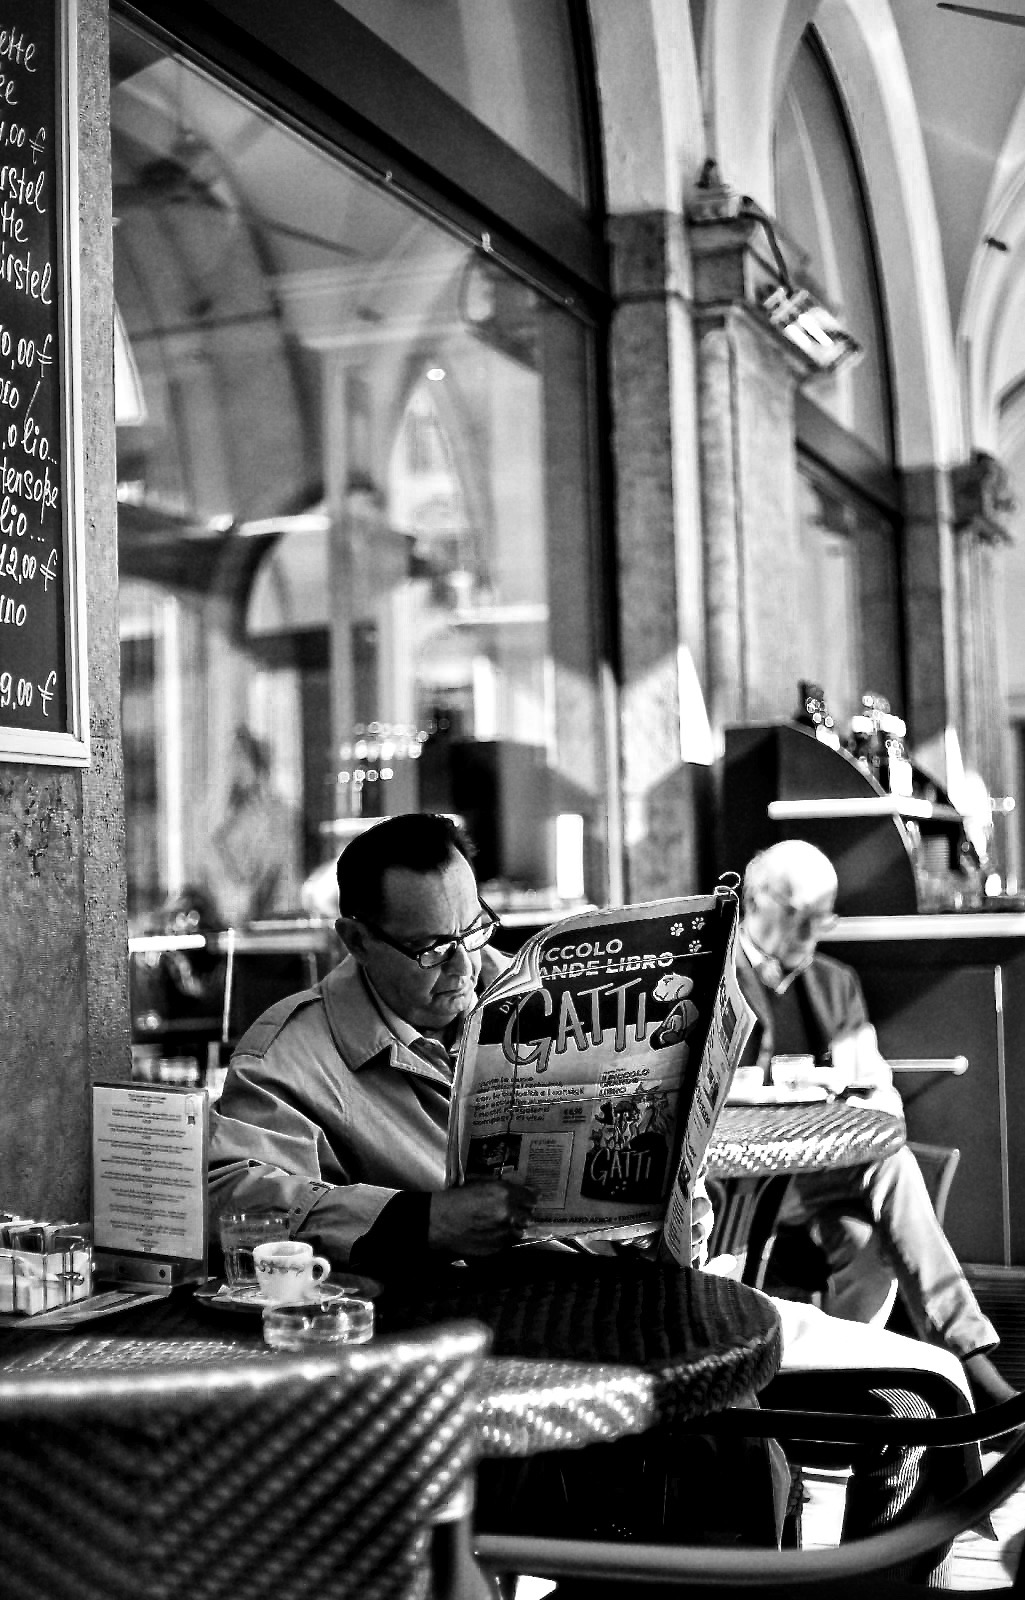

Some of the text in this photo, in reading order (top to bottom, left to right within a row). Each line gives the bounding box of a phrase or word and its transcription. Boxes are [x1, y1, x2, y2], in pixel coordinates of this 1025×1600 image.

[0, 324, 35, 370] 0,00
[605, 951, 674, 974] LIBRO
[501, 977, 647, 1074] GATTI
[589, 1147, 652, 1187] GATTI
